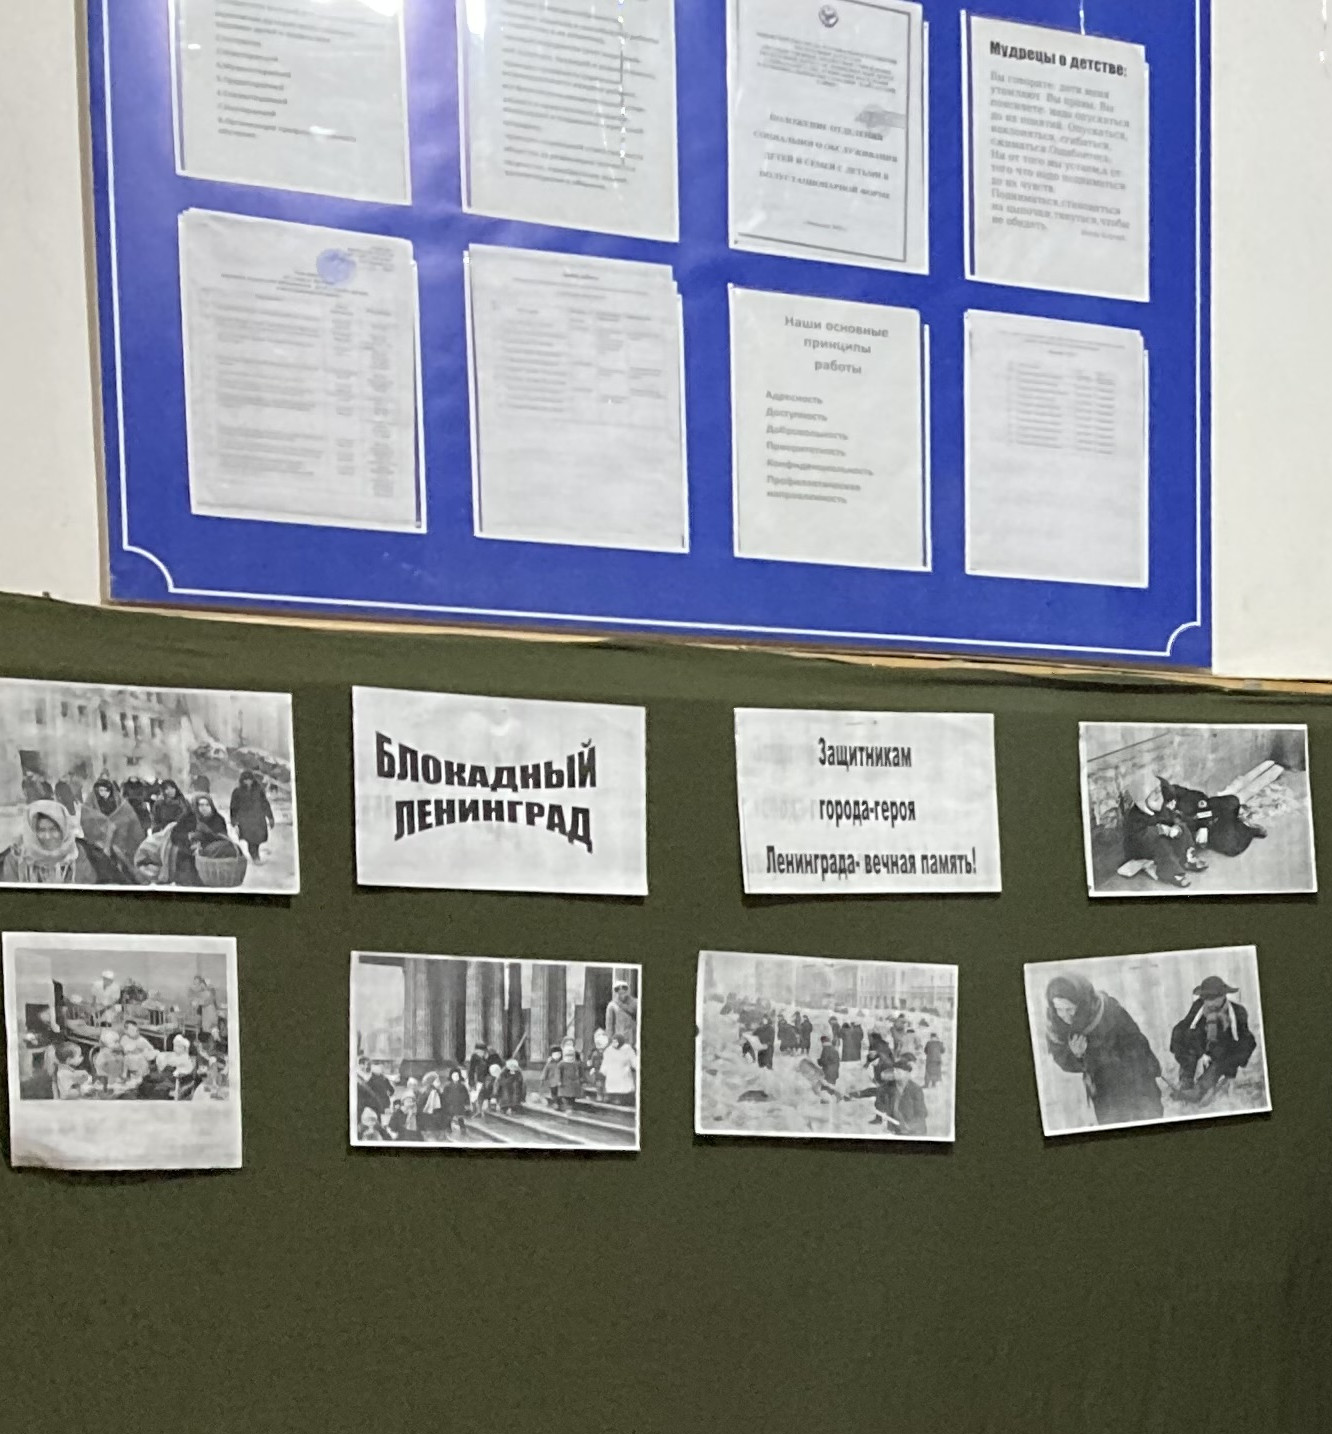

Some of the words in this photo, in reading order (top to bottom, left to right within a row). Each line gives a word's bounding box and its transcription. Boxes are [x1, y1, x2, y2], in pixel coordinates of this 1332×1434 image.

[990, 40, 1056, 64] Мудрецы
[1059, 54, 1067, 66] о
[1070, 56, 1128, 77] детстве:
[784, 316, 822, 330] Наши
[825, 322, 888, 338] основные
[804, 338, 872, 354] принципы
[814, 360, 862, 374] работы
[375, 731, 598, 792] БЛОКАДНЫЙ
[818, 737, 912, 771] Защитникам
[394, 799, 593, 854] ЛЕНИНГРАД
[819, 797, 916, 828] города-героя
[864, 854, 916, 875] вечная
[922, 847, 977, 875] память!
